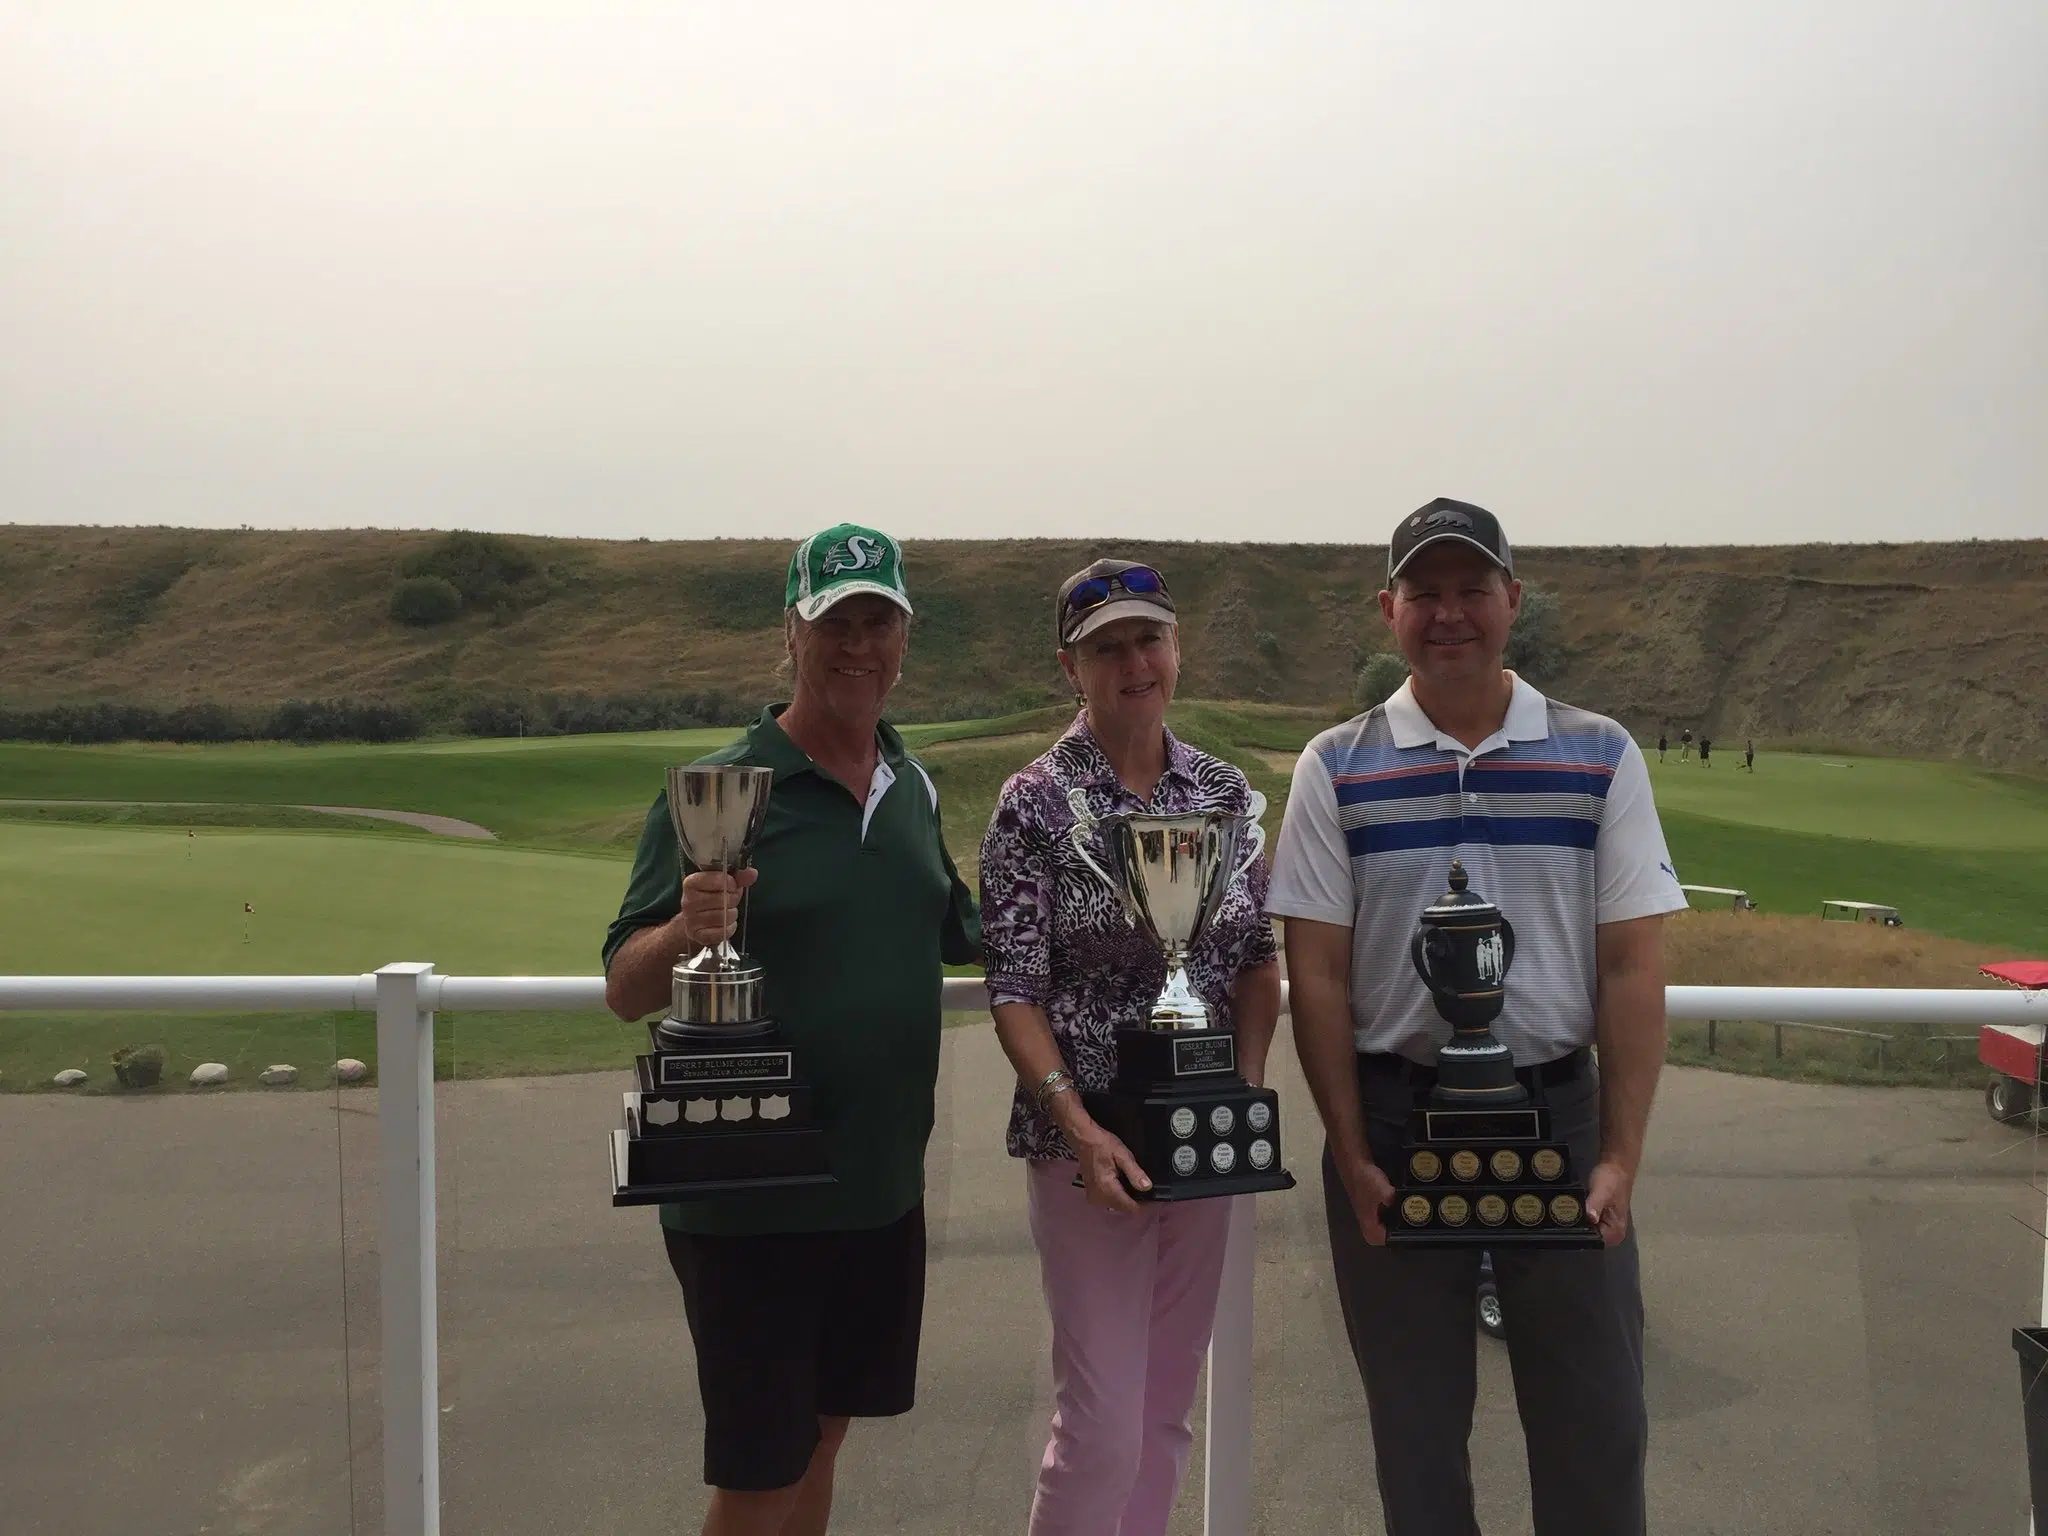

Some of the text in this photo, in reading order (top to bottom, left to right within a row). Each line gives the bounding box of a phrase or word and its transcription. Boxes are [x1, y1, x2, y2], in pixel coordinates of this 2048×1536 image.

[833, 535, 875, 575] S
[1180, 1042, 1203, 1051] DESERT
[669, 1061, 701, 1070] DESERT
[737, 1059, 759, 1067] GOLF
[761, 1058, 784, 1066] CLUB
